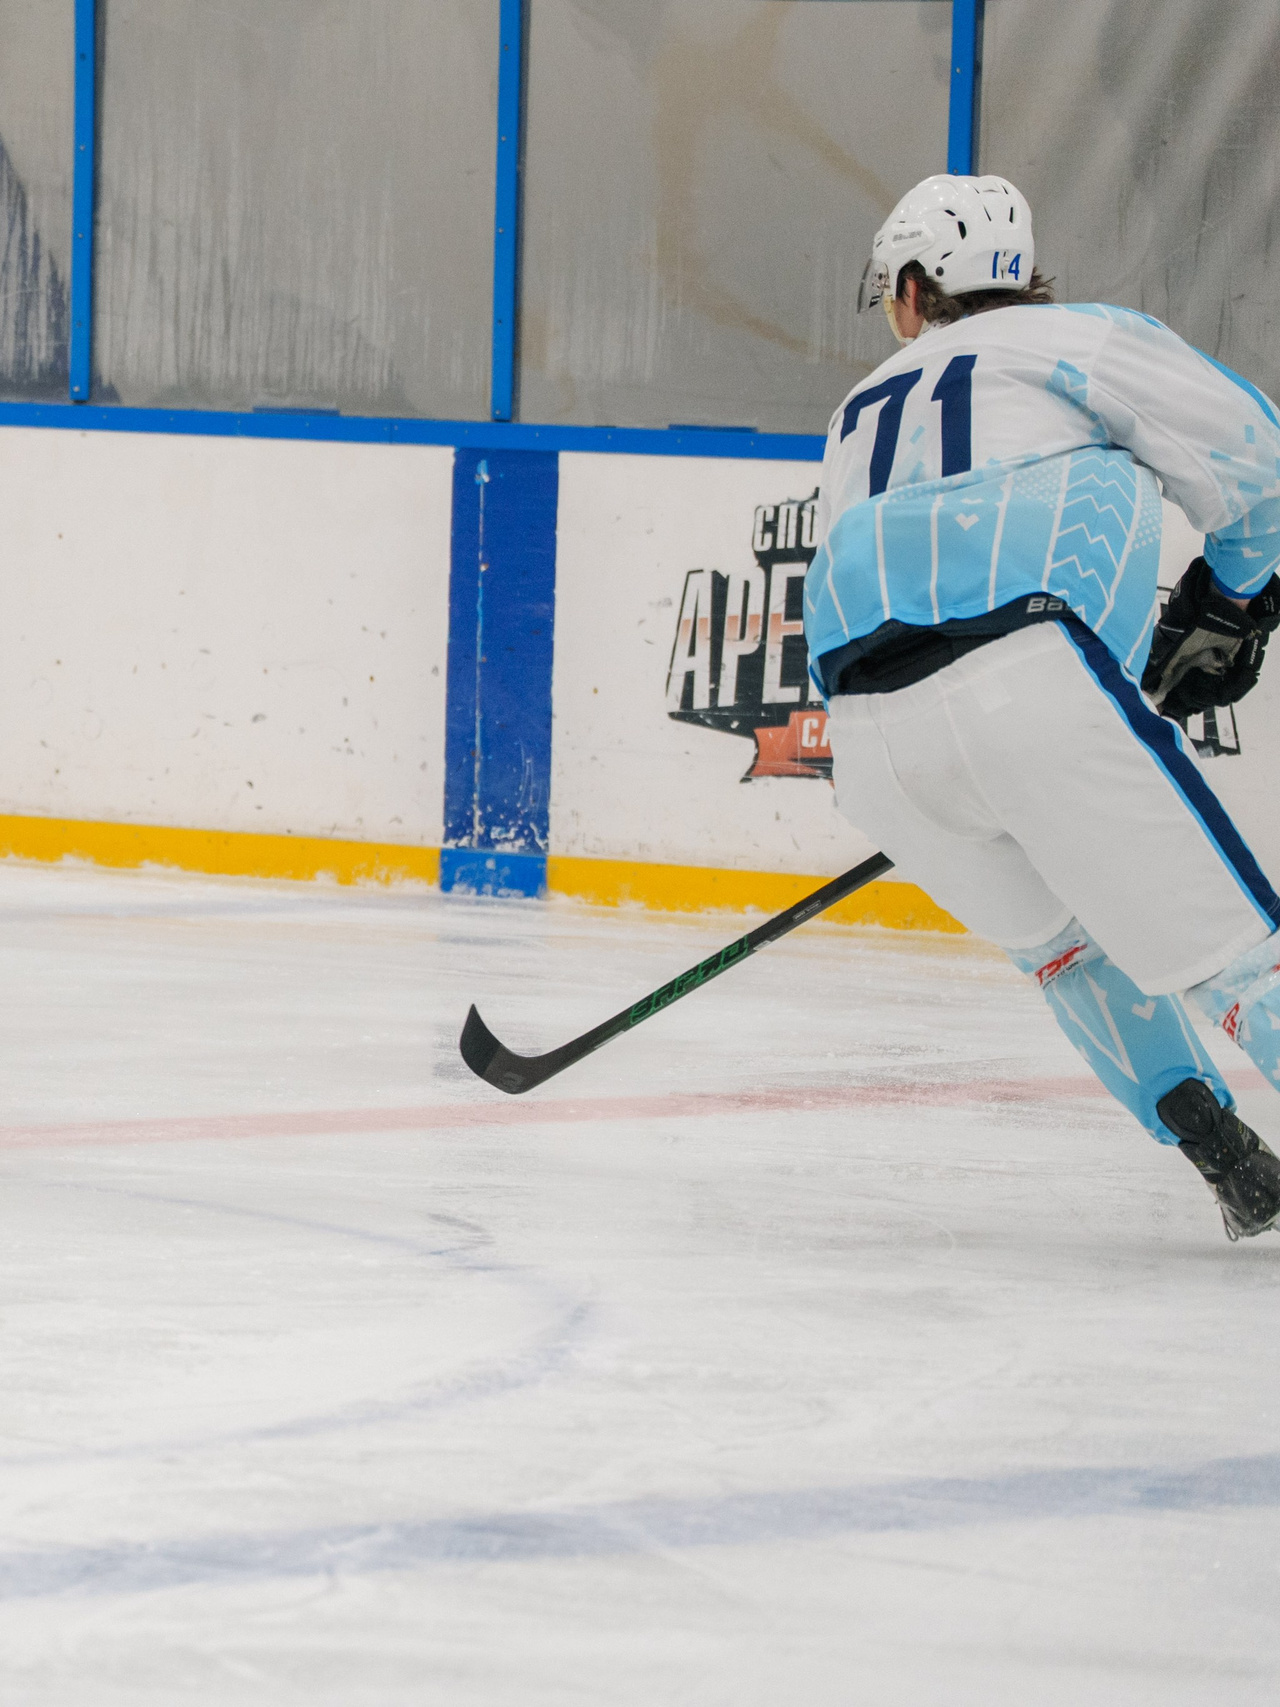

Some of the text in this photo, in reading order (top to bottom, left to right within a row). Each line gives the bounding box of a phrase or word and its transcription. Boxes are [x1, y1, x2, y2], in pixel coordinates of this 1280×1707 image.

[992, 252, 1021, 280] 14
[840, 354, 978, 499] 71
[668, 562, 824, 711] АРЕ
